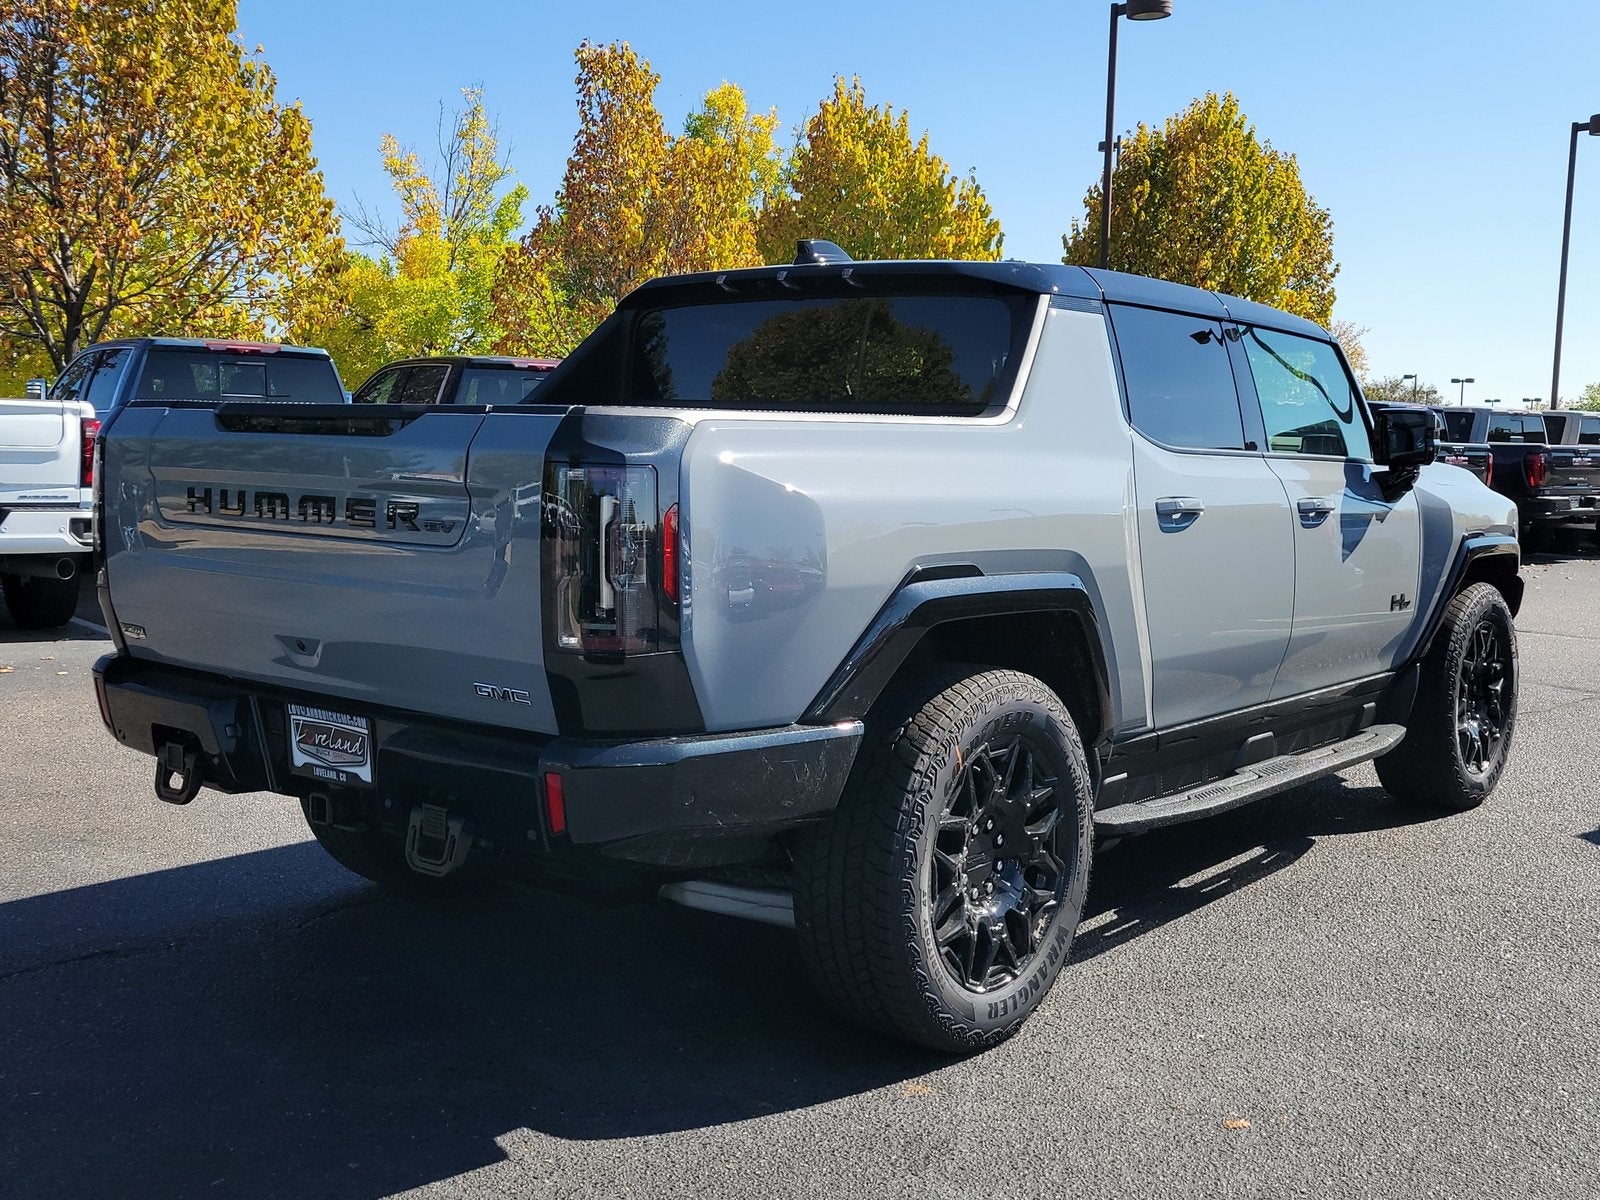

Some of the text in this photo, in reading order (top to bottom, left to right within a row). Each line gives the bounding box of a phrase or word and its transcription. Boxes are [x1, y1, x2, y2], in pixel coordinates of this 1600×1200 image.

[187, 486, 420, 532] HUMMER
[473, 682, 532, 706] GMC
[987, 925, 1070, 1019] WRANGLER
